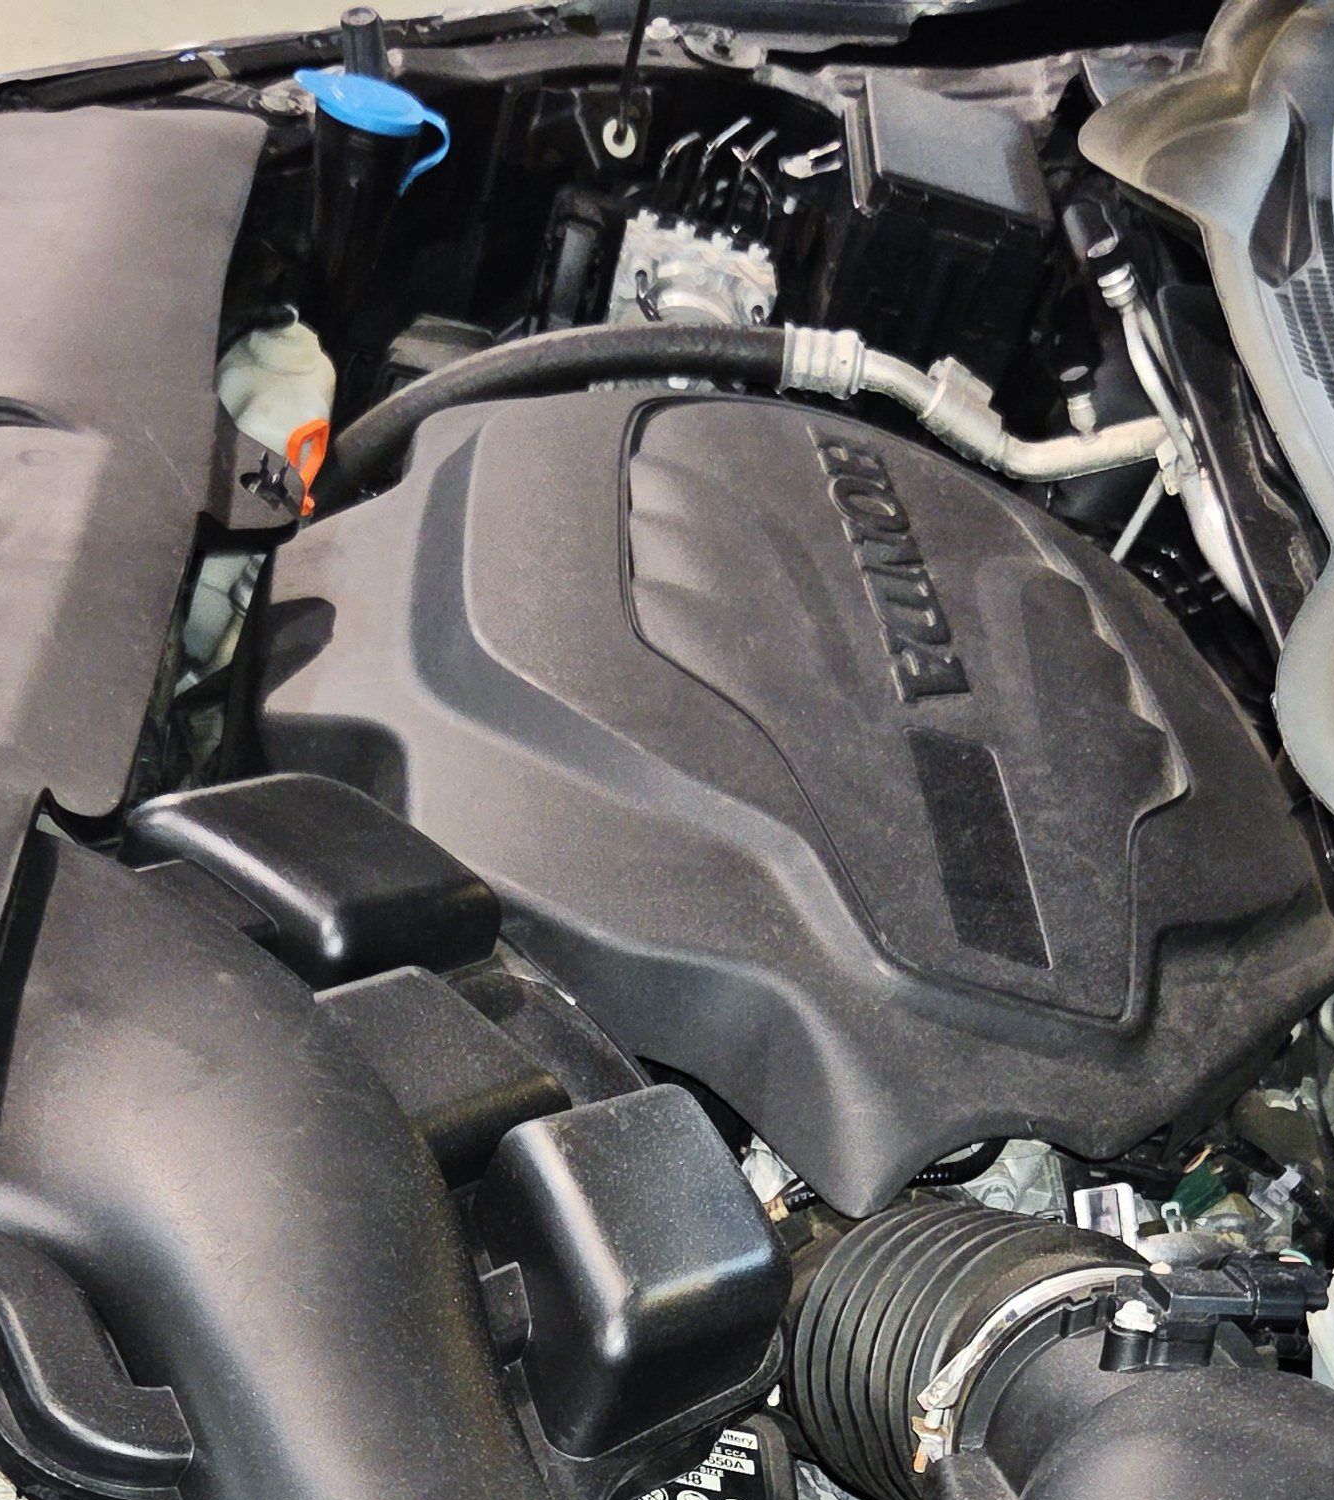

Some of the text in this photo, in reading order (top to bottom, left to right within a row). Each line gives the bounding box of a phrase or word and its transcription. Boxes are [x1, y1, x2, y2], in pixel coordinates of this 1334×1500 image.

[806, 424, 970, 701] HONDA
[724, 1448, 747, 1459] CCA
[708, 1456, 745, 1470] 650A
[699, 1466, 724, 1478] SIZE
